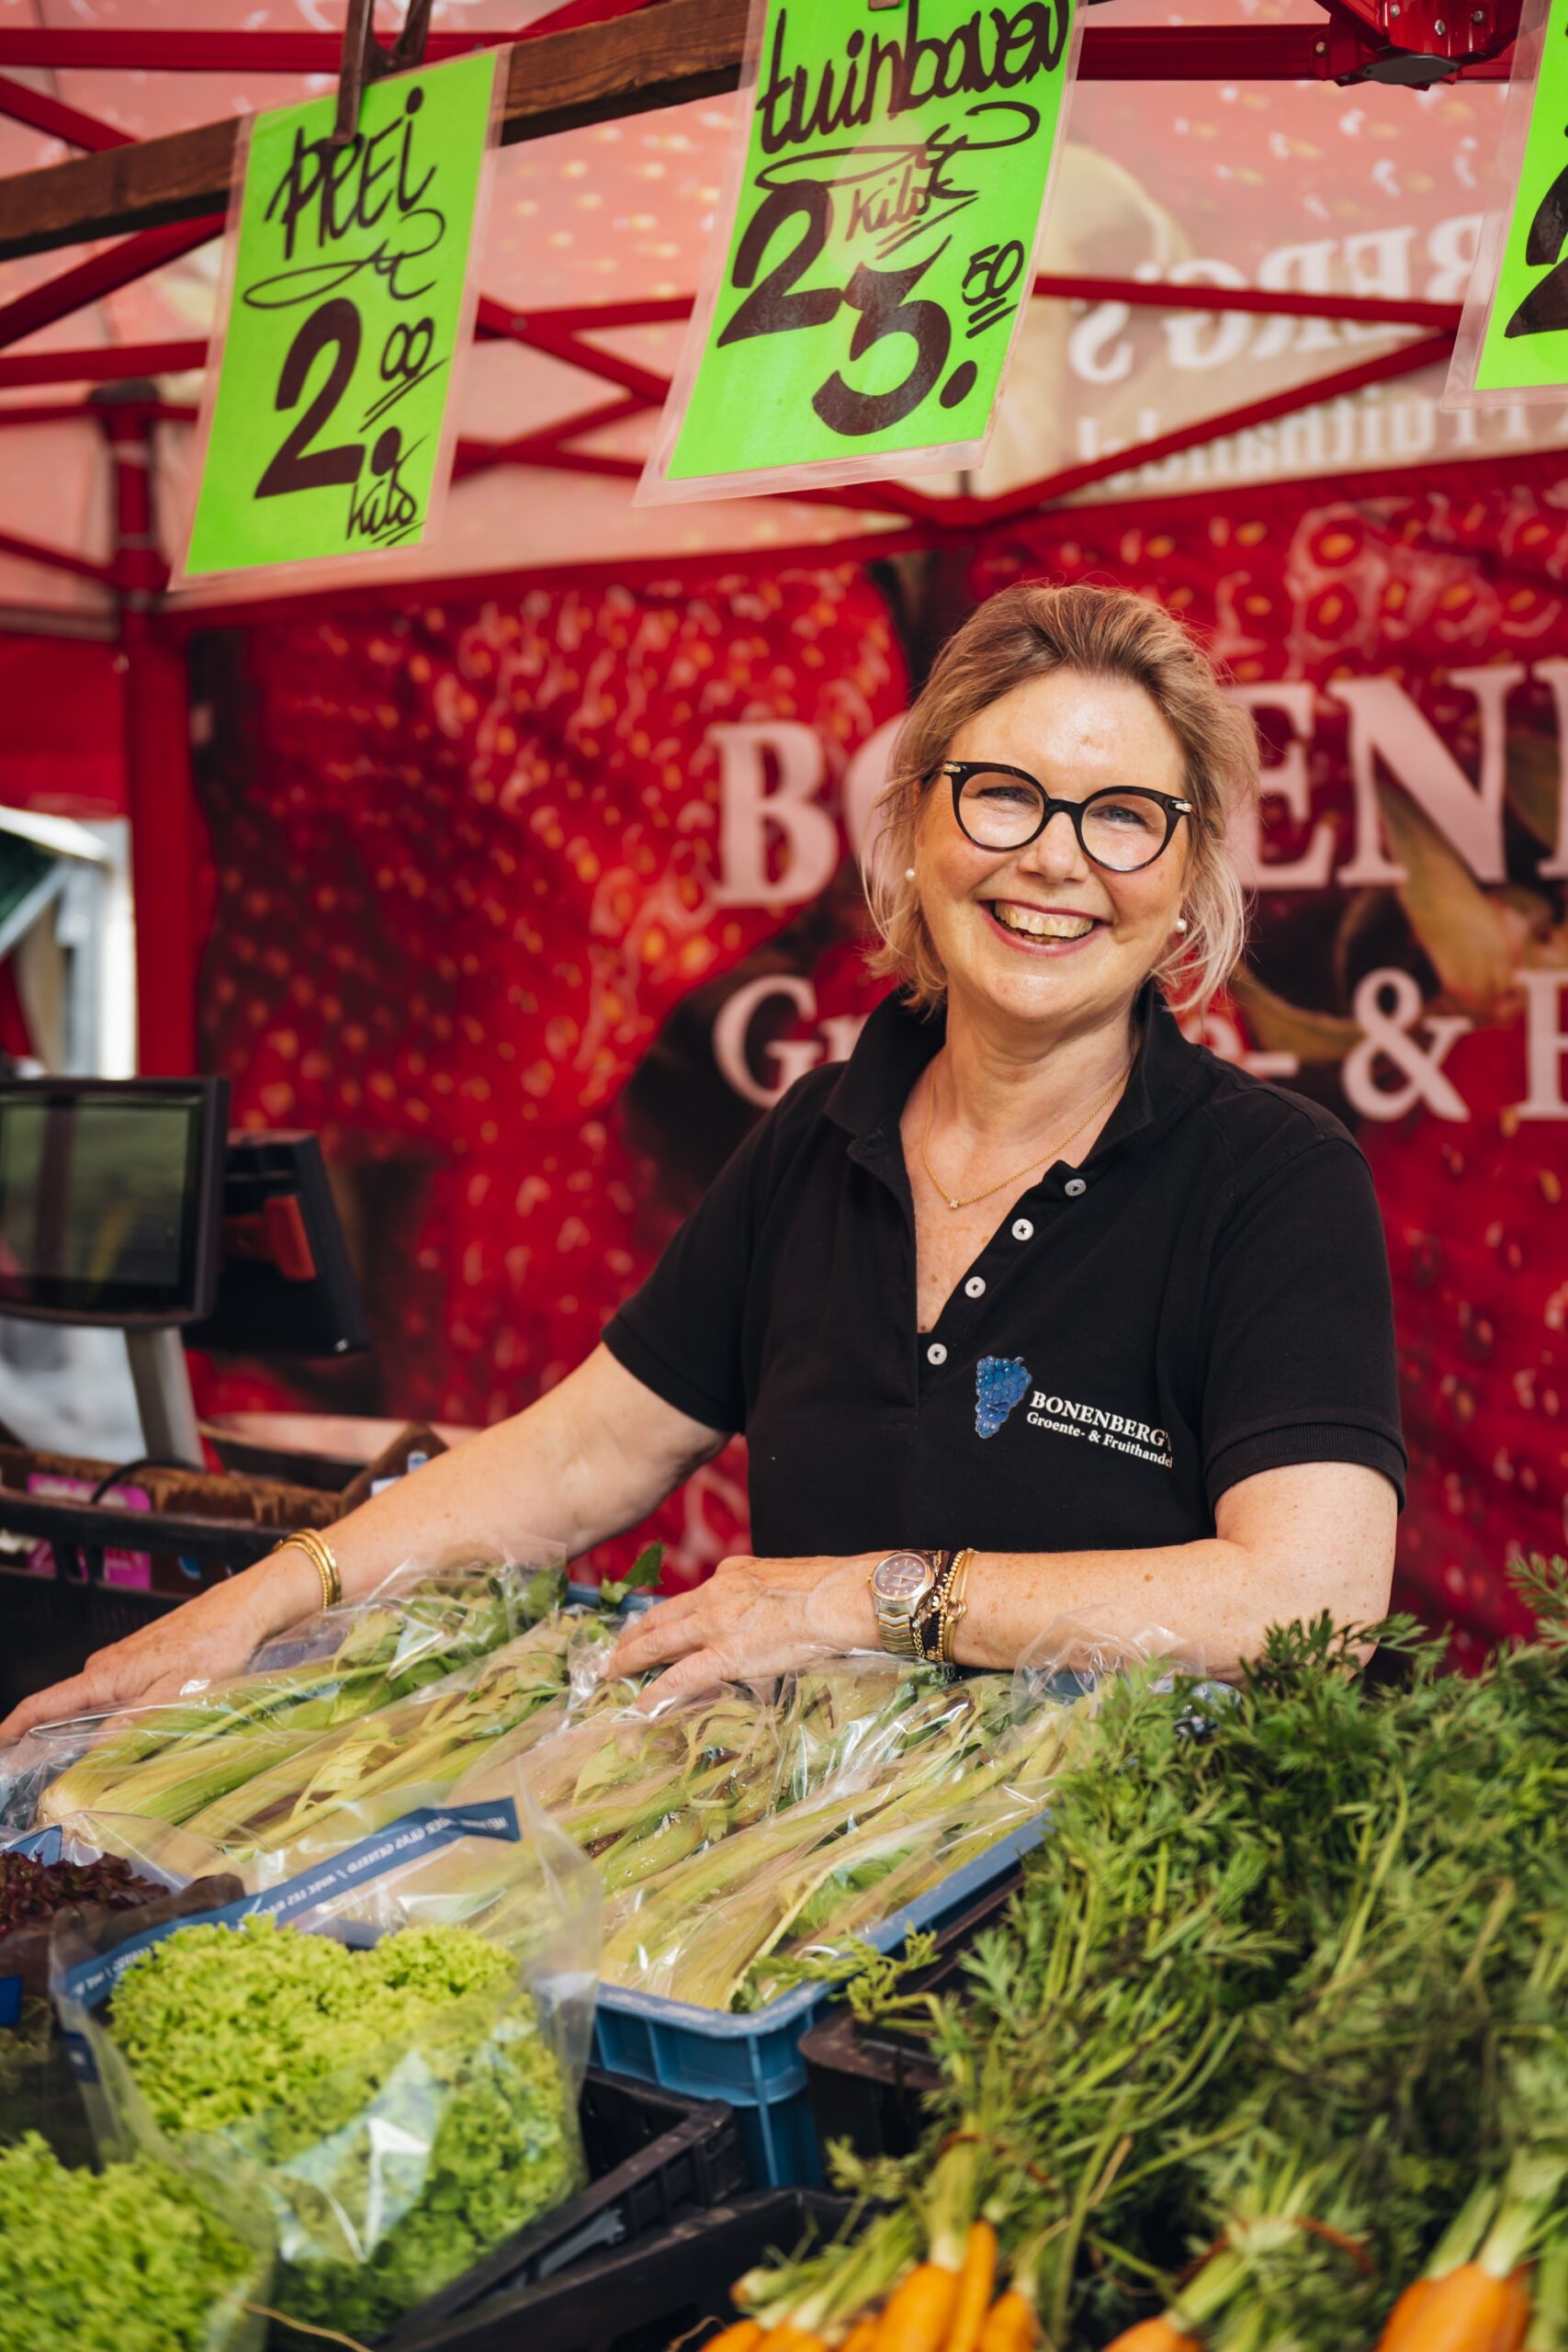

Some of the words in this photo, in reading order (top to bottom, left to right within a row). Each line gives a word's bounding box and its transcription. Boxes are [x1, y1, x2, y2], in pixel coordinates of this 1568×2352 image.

[1342, 966, 1472, 1122] &
[1026, 1410, 1086, 1438] Groente-
[1087, 1429, 1101, 1444] &
